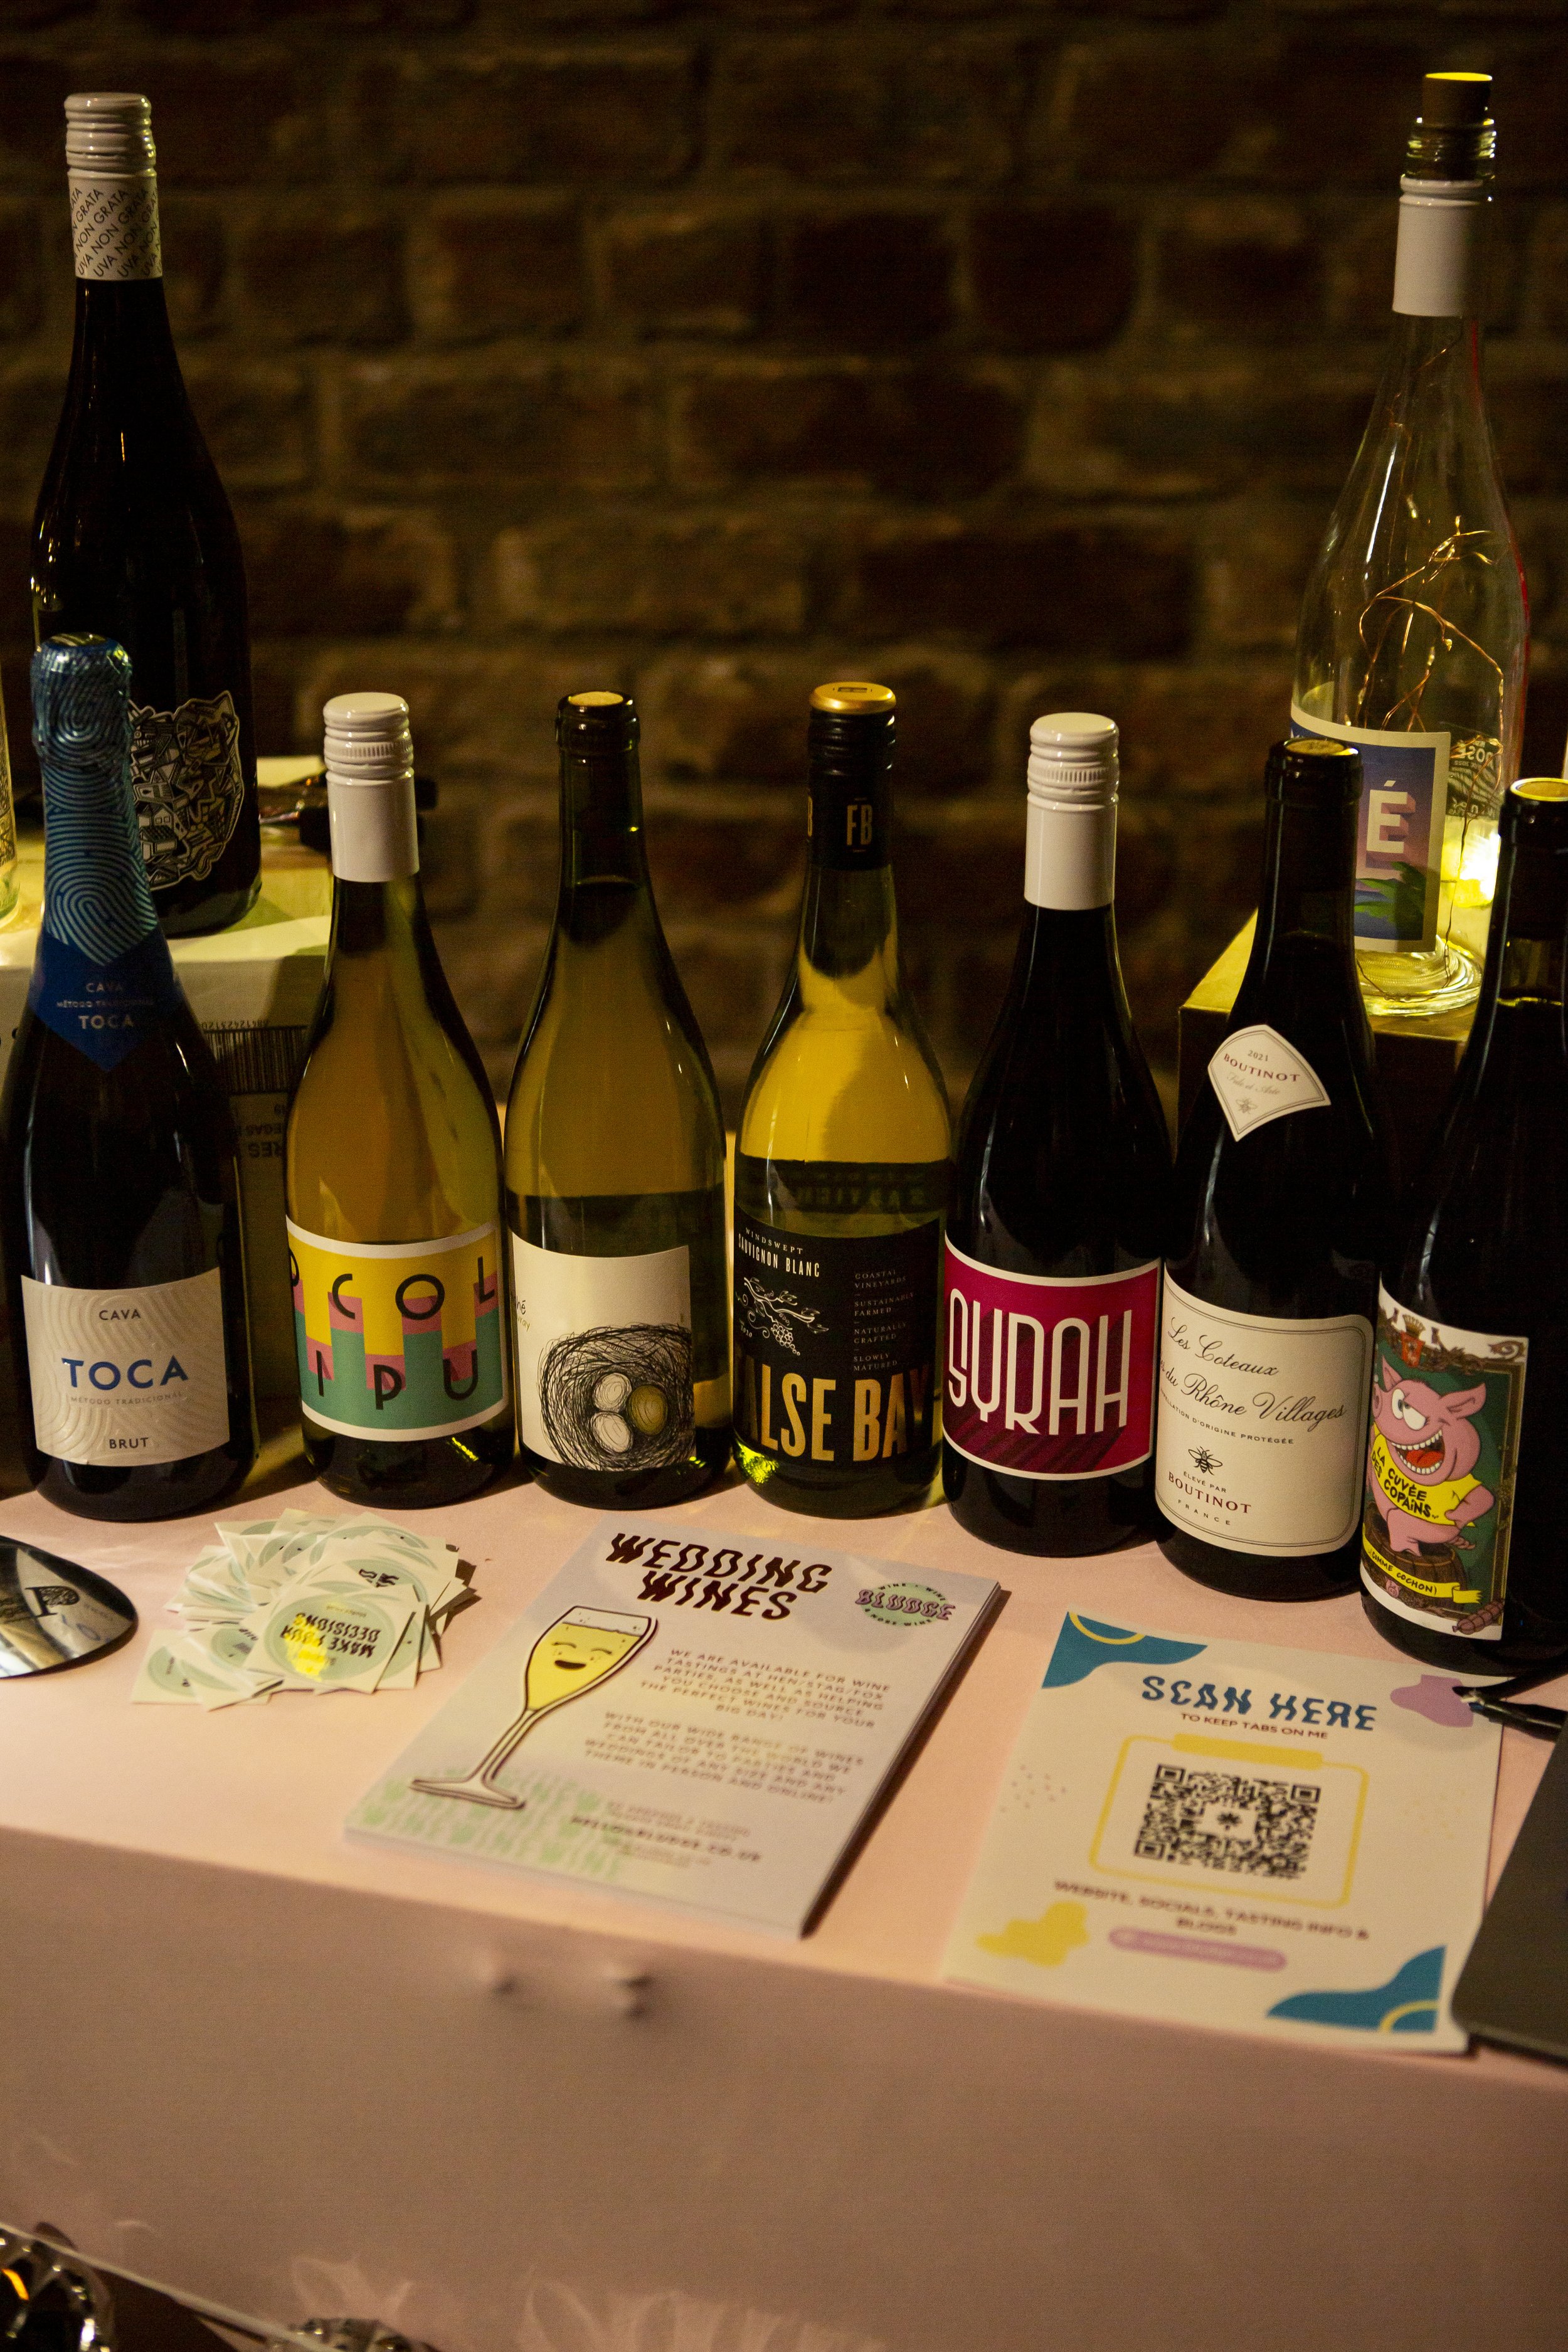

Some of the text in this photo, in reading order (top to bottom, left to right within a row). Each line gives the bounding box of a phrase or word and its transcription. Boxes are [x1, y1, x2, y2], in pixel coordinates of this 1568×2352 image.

[76, 188, 103, 223] GRATA
[76, 189, 129, 252] NON GRATA
[78, 254, 93, 275] UVA
[91, 223, 120, 255] NON
[93, 255, 117, 277] UVA
[117, 255, 139, 277] UVA
[846, 804, 872, 845] FB
[78, 1014, 134, 1029] TOCA
[1224, 1053, 1300, 1083] BOUTINOT
[1248, 1049, 1268, 1062] 2021
[739, 1233, 820, 1278] SAUVIGNON BLANC
[745, 1227, 803, 1254] WINDSWEPT
[855, 1276, 907, 1289] VINEYARDS
[98, 1308, 141, 1321] CAVA
[854, 1306, 892, 1317] FARMED
[854, 1333, 897, 1344] CRAFTED
[1167, 1317, 1191, 1350] Les
[1194, 1335, 1279, 1376] Coteaux
[854, 1353, 890, 1362] SLOWLY
[854, 1359, 898, 1372] MATURED
[948, 1288, 1132, 1436] SYRAH
[61, 1355, 188, 1391] TOCA
[70, 1395, 111, 1406] MÉTODO
[1165, 1367, 1347, 1433] du Rhône Villages
[109, 1437, 149, 1449] BRUT
[1192, 1418, 1236, 1437] D'ORIGINE
[1240, 1433, 1295, 1444] PROTÉGÉE
[1372, 1450, 1383, 1478] DES
[1377, 1446, 1428, 1502] LA CUVÉE
[1168, 1471, 1252, 1514] BOUTINOT
[1183, 1471, 1227, 1493] ÉLEVÉ PAR
[1178, 1499, 1231, 1526] FRANCE
[605, 1532, 833, 1594] WEDDING
[637, 1570, 798, 1621] WINES
[854, 1589, 956, 1621] BLUDGE
[293, 1612, 381, 1643] DECISIONS
[327, 1637, 376, 1659] MAKE
[668, 1656, 736, 1675] TASTINGS
[743, 1670, 762, 1680] AT
[671, 1648, 890, 1692] WE ARE AVAILABLE FOR WINE
[642, 1681, 874, 1728] THE PERFECT WINES FOR YOUR
[664, 1675, 862, 1717] YOU CHOOSE AND SOURCE
[725, 1677, 743, 1687] AS
[750, 1681, 785, 1693] WELL
[794, 1688, 811, 1698] AS
[819, 1693, 883, 1711] HELPING
[1142, 1675, 1377, 1731] SCAN HERE
[1181, 1712, 1329, 1740] TO KEEP TABS ON ME
